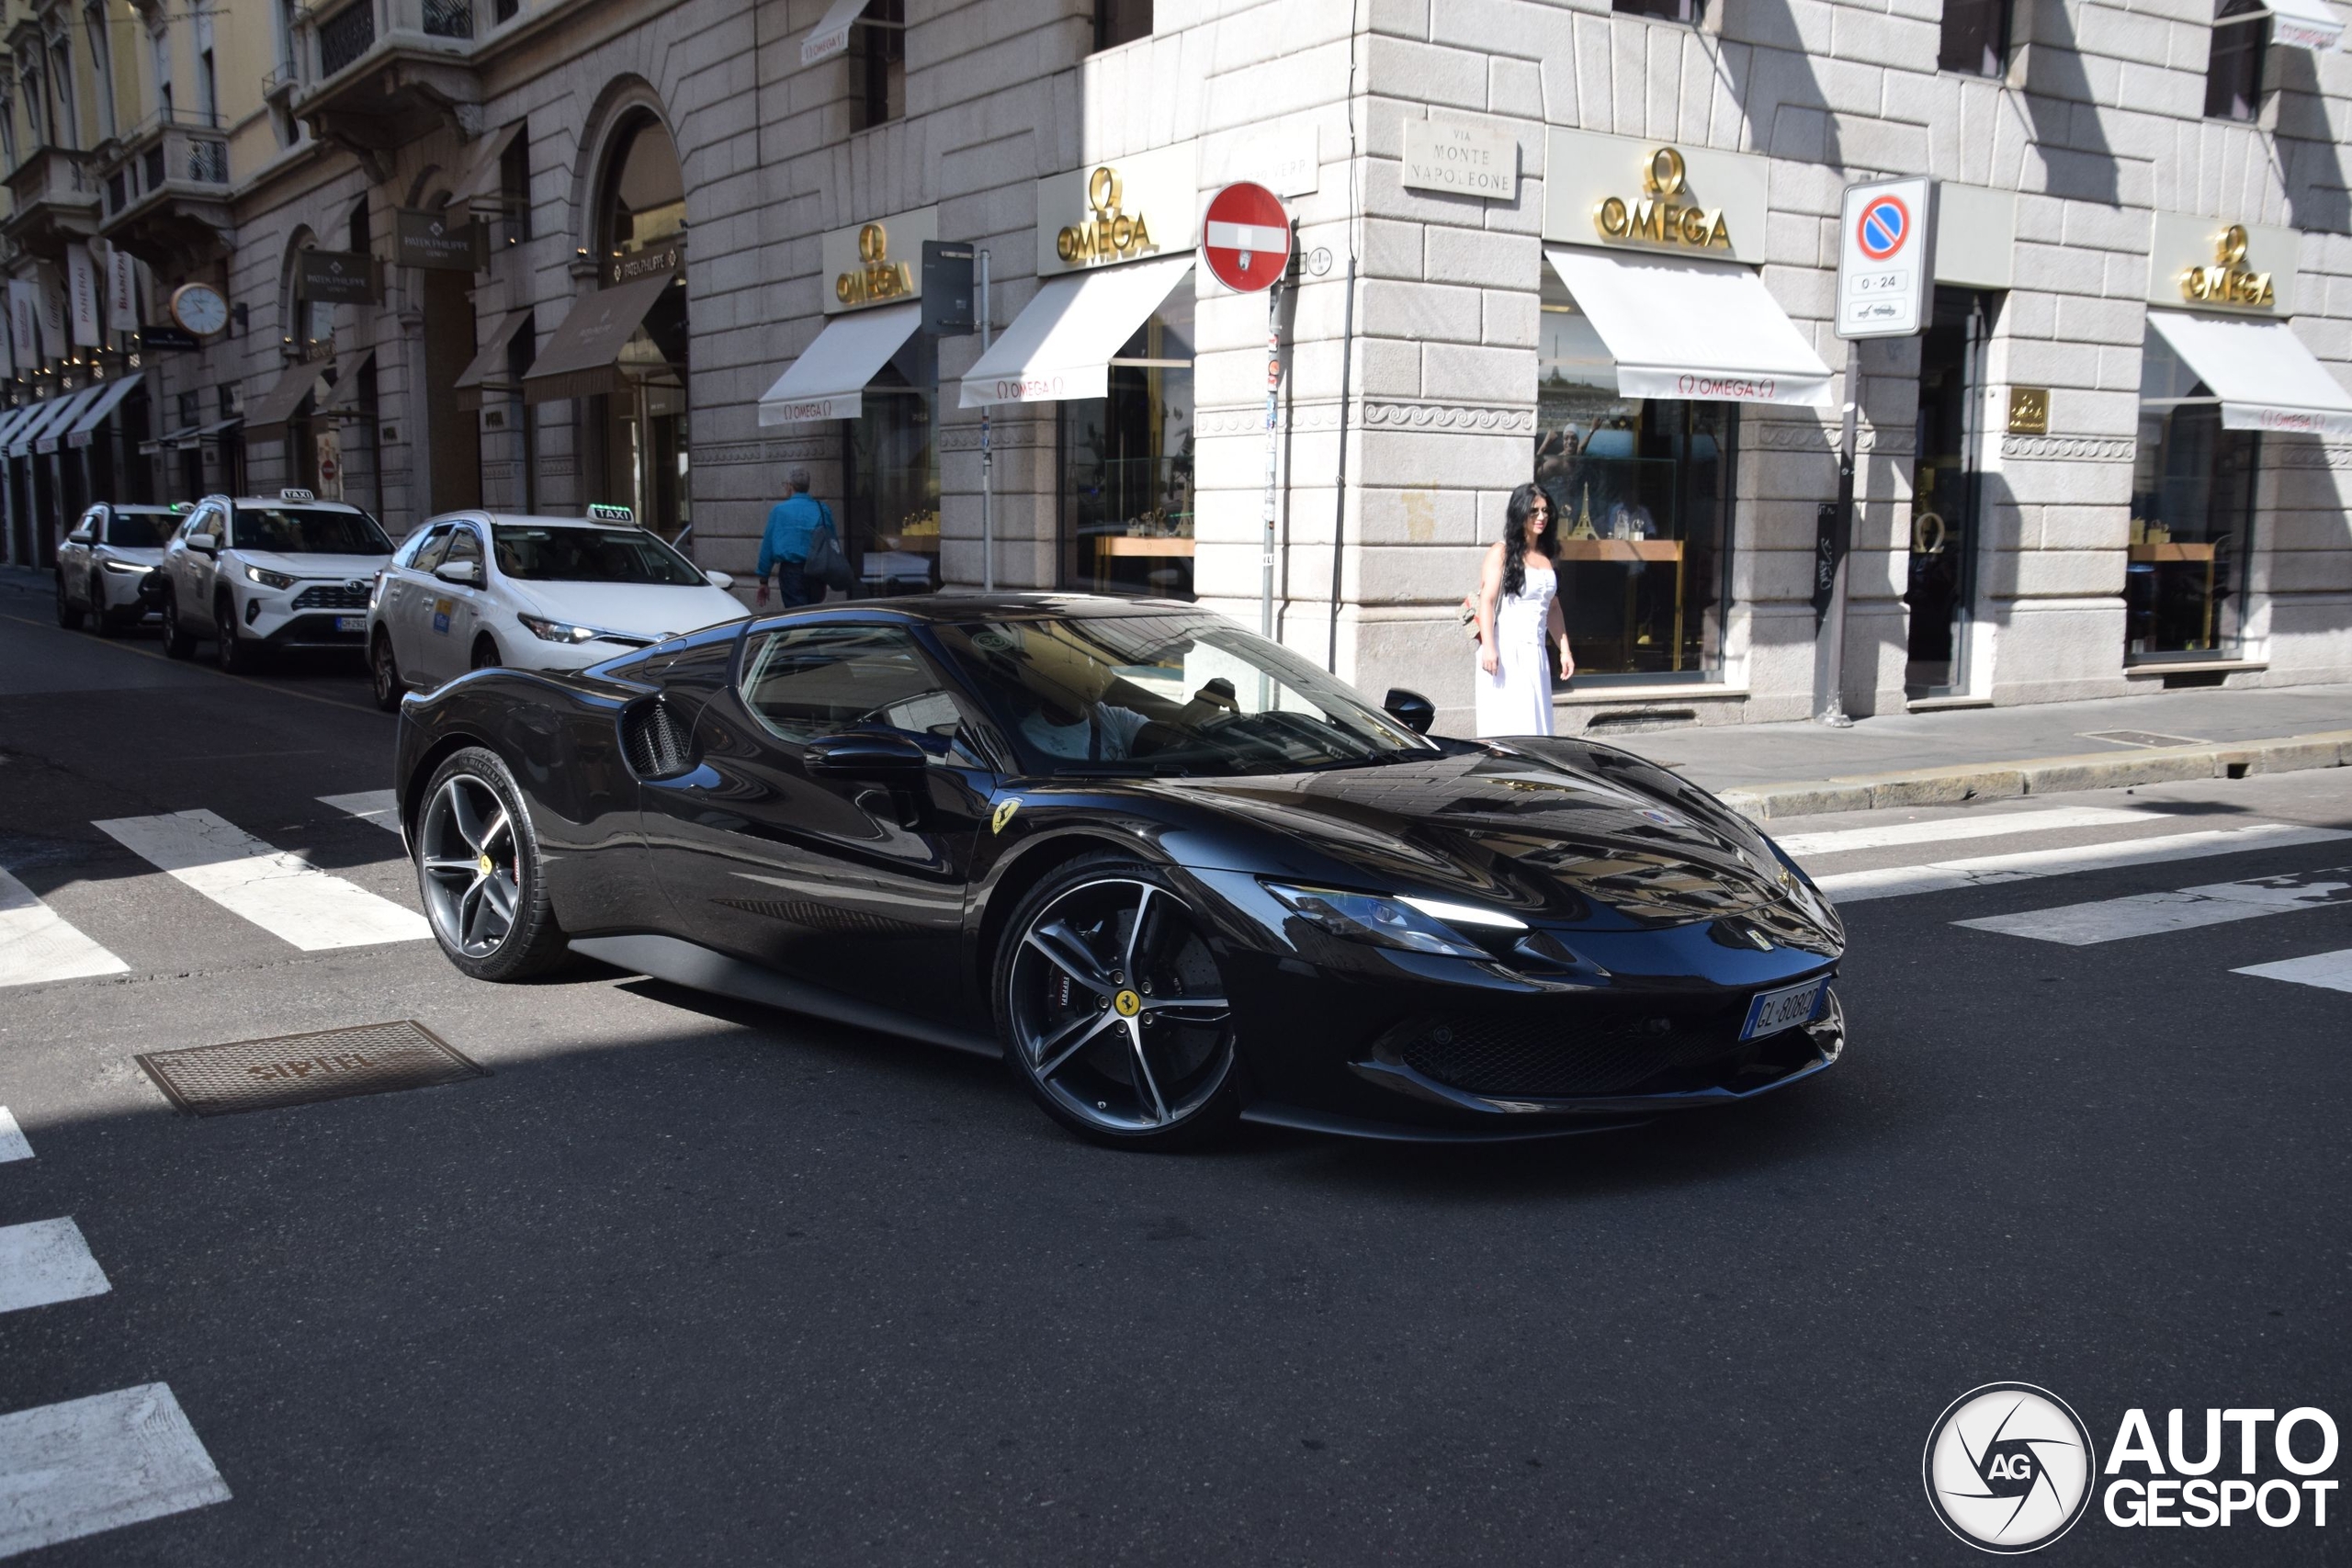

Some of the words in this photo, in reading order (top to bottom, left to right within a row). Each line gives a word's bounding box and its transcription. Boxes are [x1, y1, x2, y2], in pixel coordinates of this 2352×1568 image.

[1453, 130, 1471, 141] VIA
[1433, 143, 1490, 165] MONTE
[1410, 164, 1510, 191] NAPOLEONE
[1592, 196, 1733, 250] OMEGA
[1057, 212, 1155, 263] OMEGA
[836, 260, 912, 304] OMEGA
[1861, 277, 1870, 289] 0
[1881, 276, 1896, 288] 24
[2178, 265, 2276, 307] OMEGA
[1011, 379, 1049, 398] OMEGA
[1700, 377, 1755, 399] OMEGA
[794, 402, 822, 419] OMEGA
[286, 491, 311, 500] TAXI
[596, 509, 628, 520] TAXI
[469, 758, 505, 788] MICHELIN
[1061, 976, 1070, 1006] Ferrari
[1757, 1000, 1776, 1029] GL
